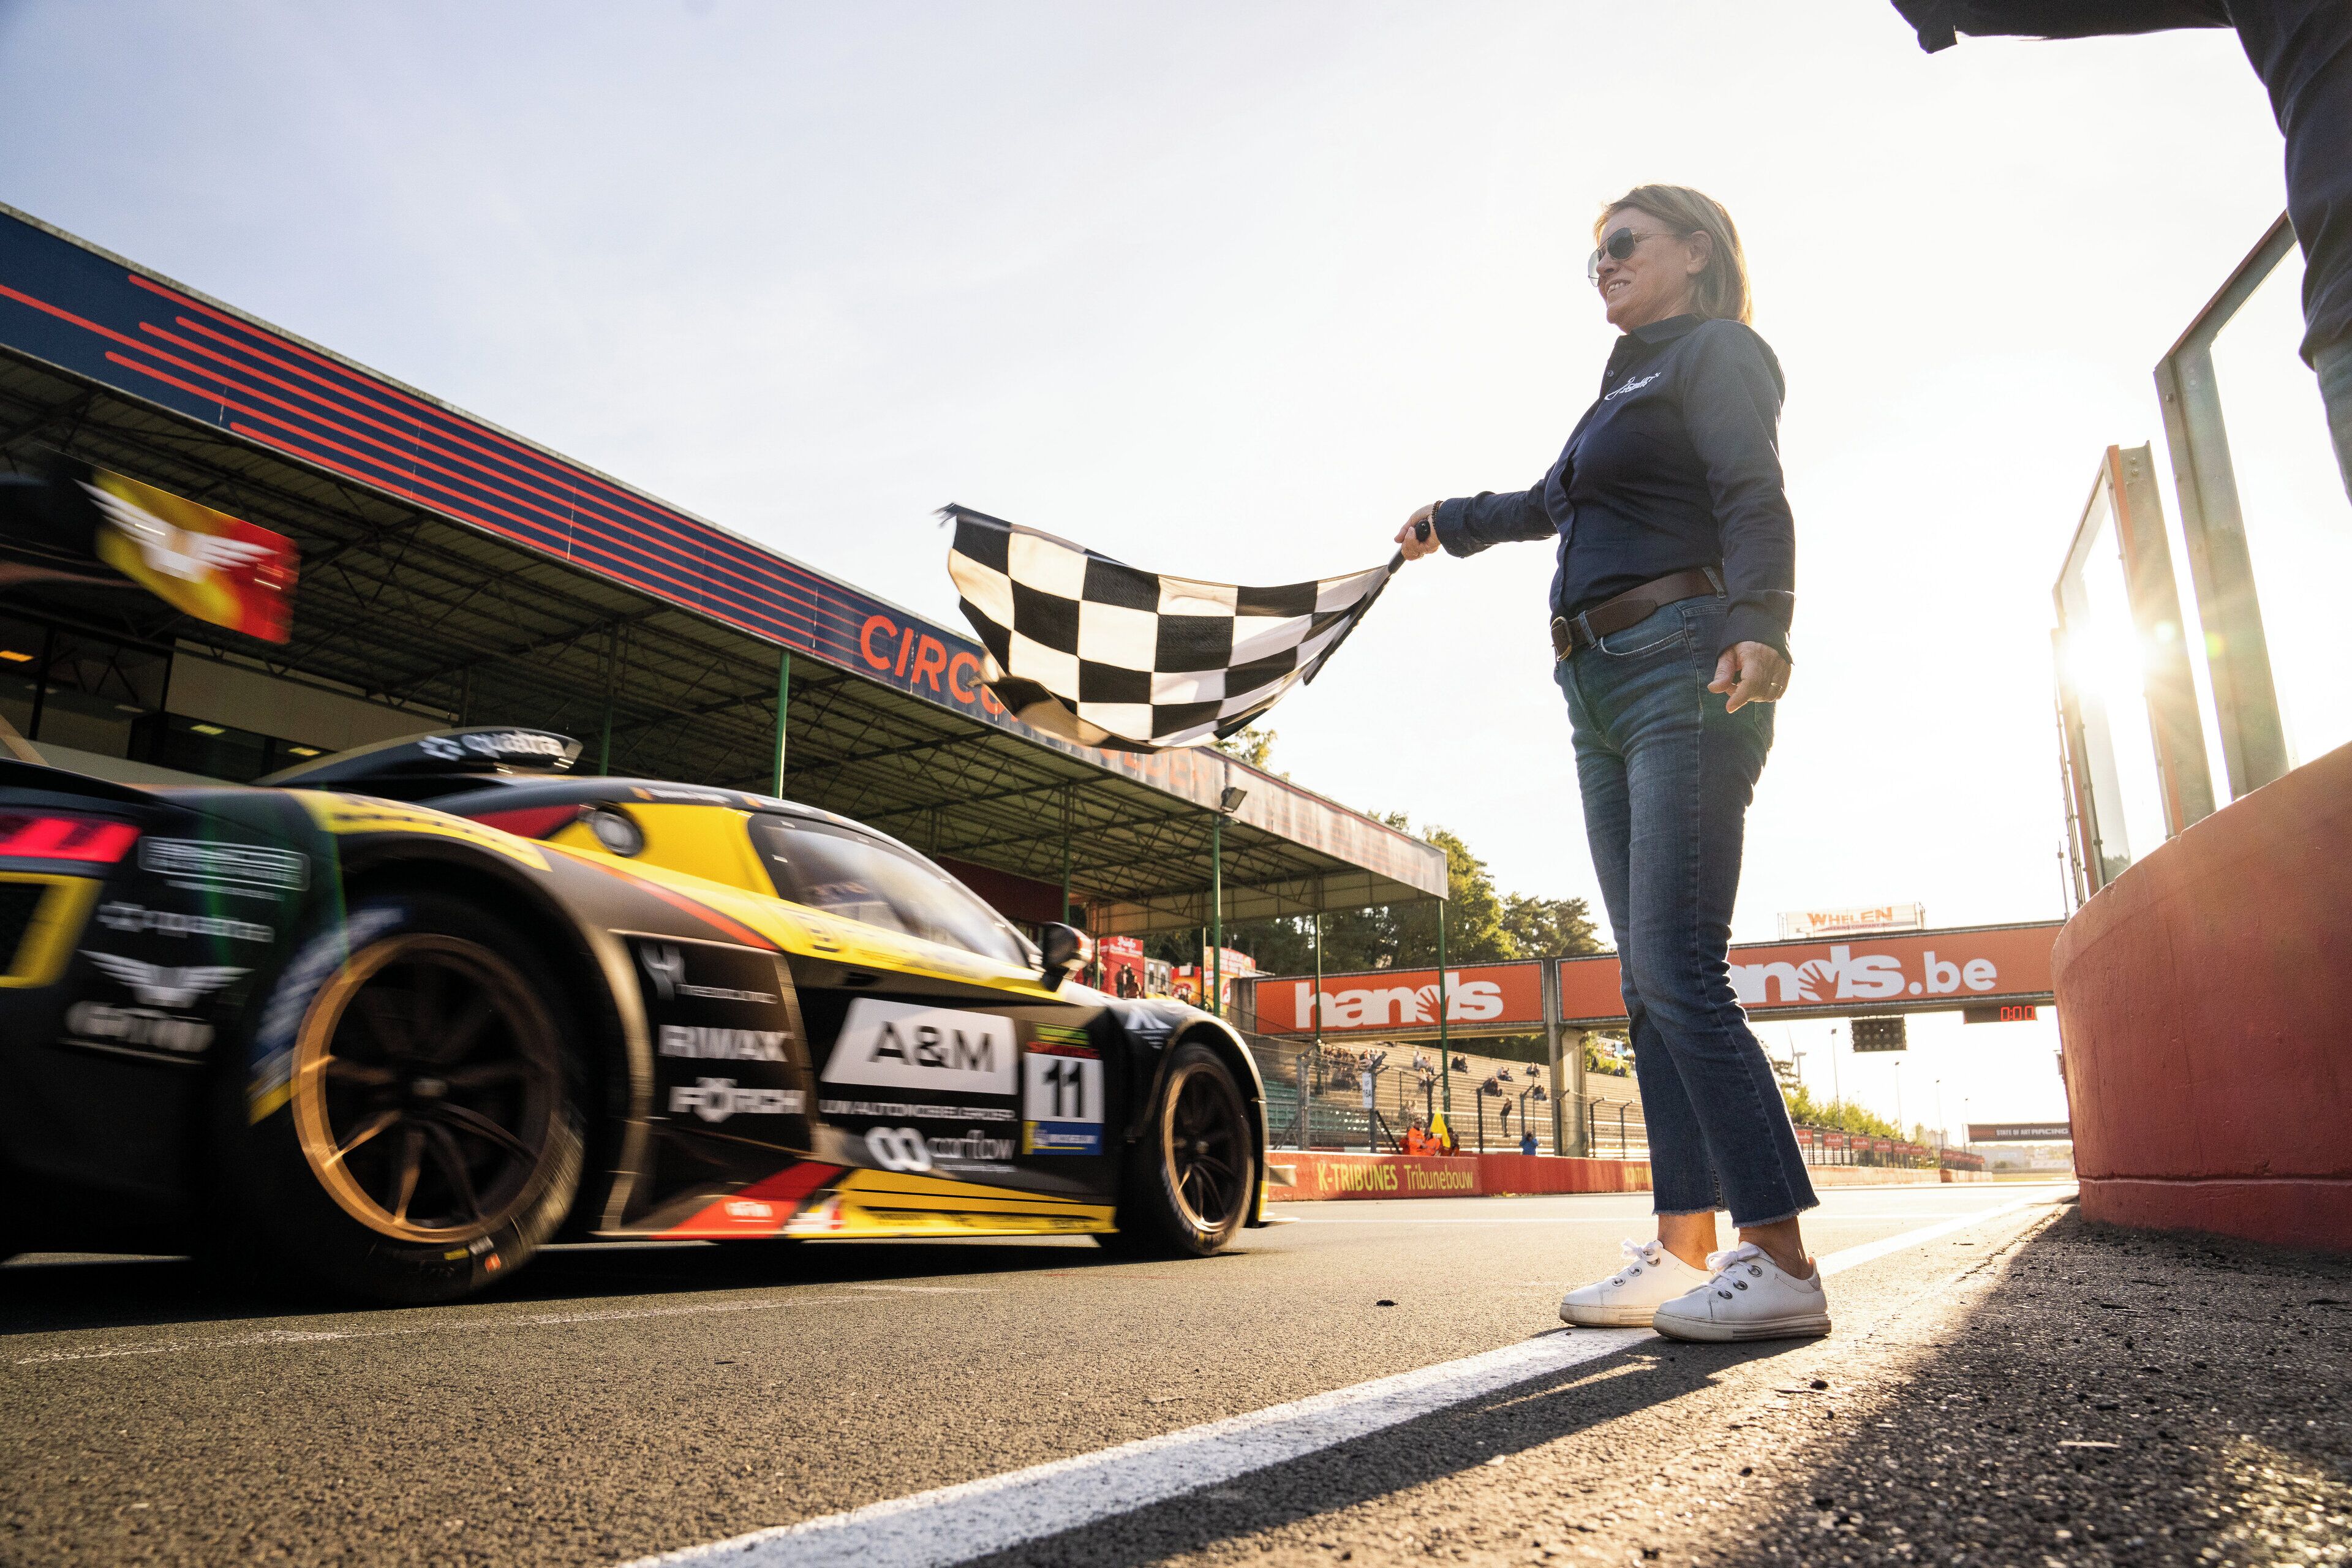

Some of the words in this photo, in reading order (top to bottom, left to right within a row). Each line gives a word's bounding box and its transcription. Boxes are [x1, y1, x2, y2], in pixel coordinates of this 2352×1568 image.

[1807, 907, 1892, 927] WHELEN
[1295, 971, 1504, 1029] hands
[1730, 945, 1997, 1004] nds.be
[658, 1025, 793, 1062] RIWAX
[866, 1020, 995, 1073] A&M
[1043, 1059, 1086, 1118] 11
[1317, 1162, 1398, 1191] K-TRIBUNES
[1404, 1164, 1473, 1190] Tribunebouw
